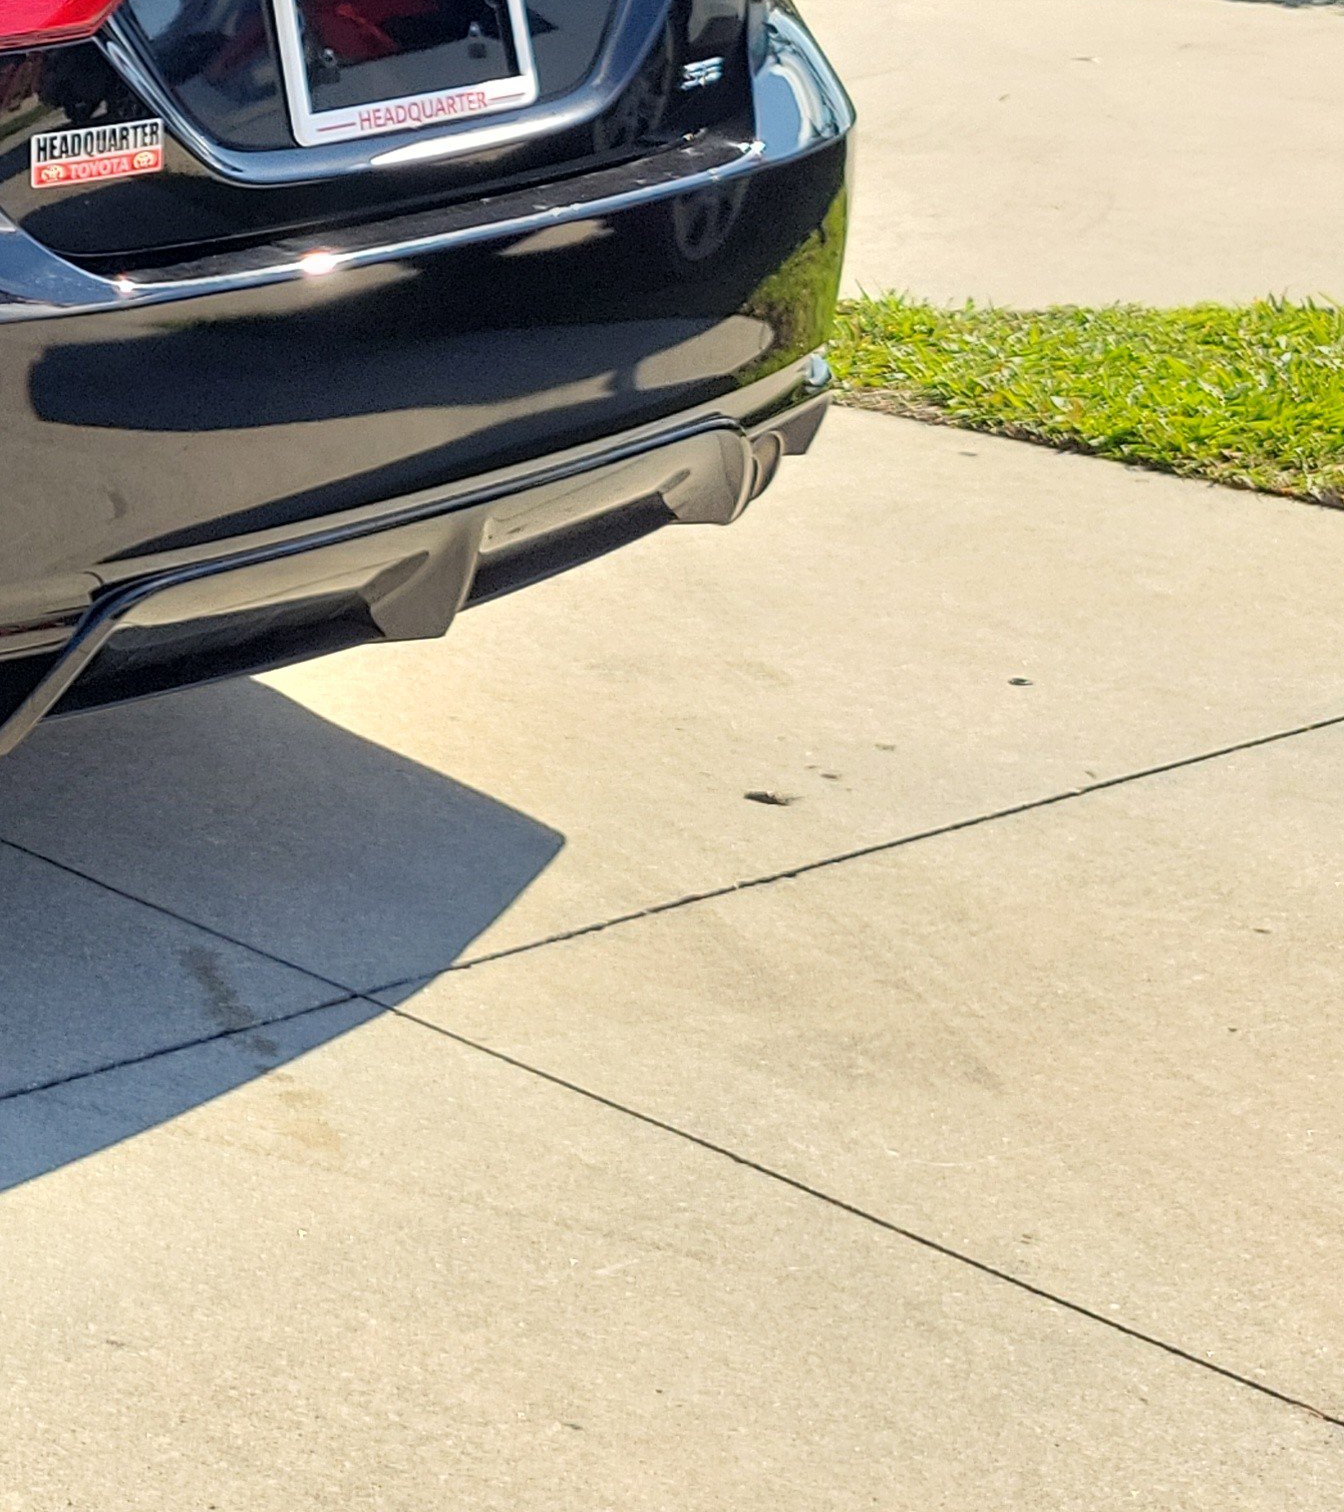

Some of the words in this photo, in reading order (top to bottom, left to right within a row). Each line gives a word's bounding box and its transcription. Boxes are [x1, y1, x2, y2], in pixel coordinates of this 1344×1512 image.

[358, 91, 489, 131] HEADQUARTER
[36, 121, 160, 163] HEADQUARTER
[69, 158, 131, 180] TOYOTA
